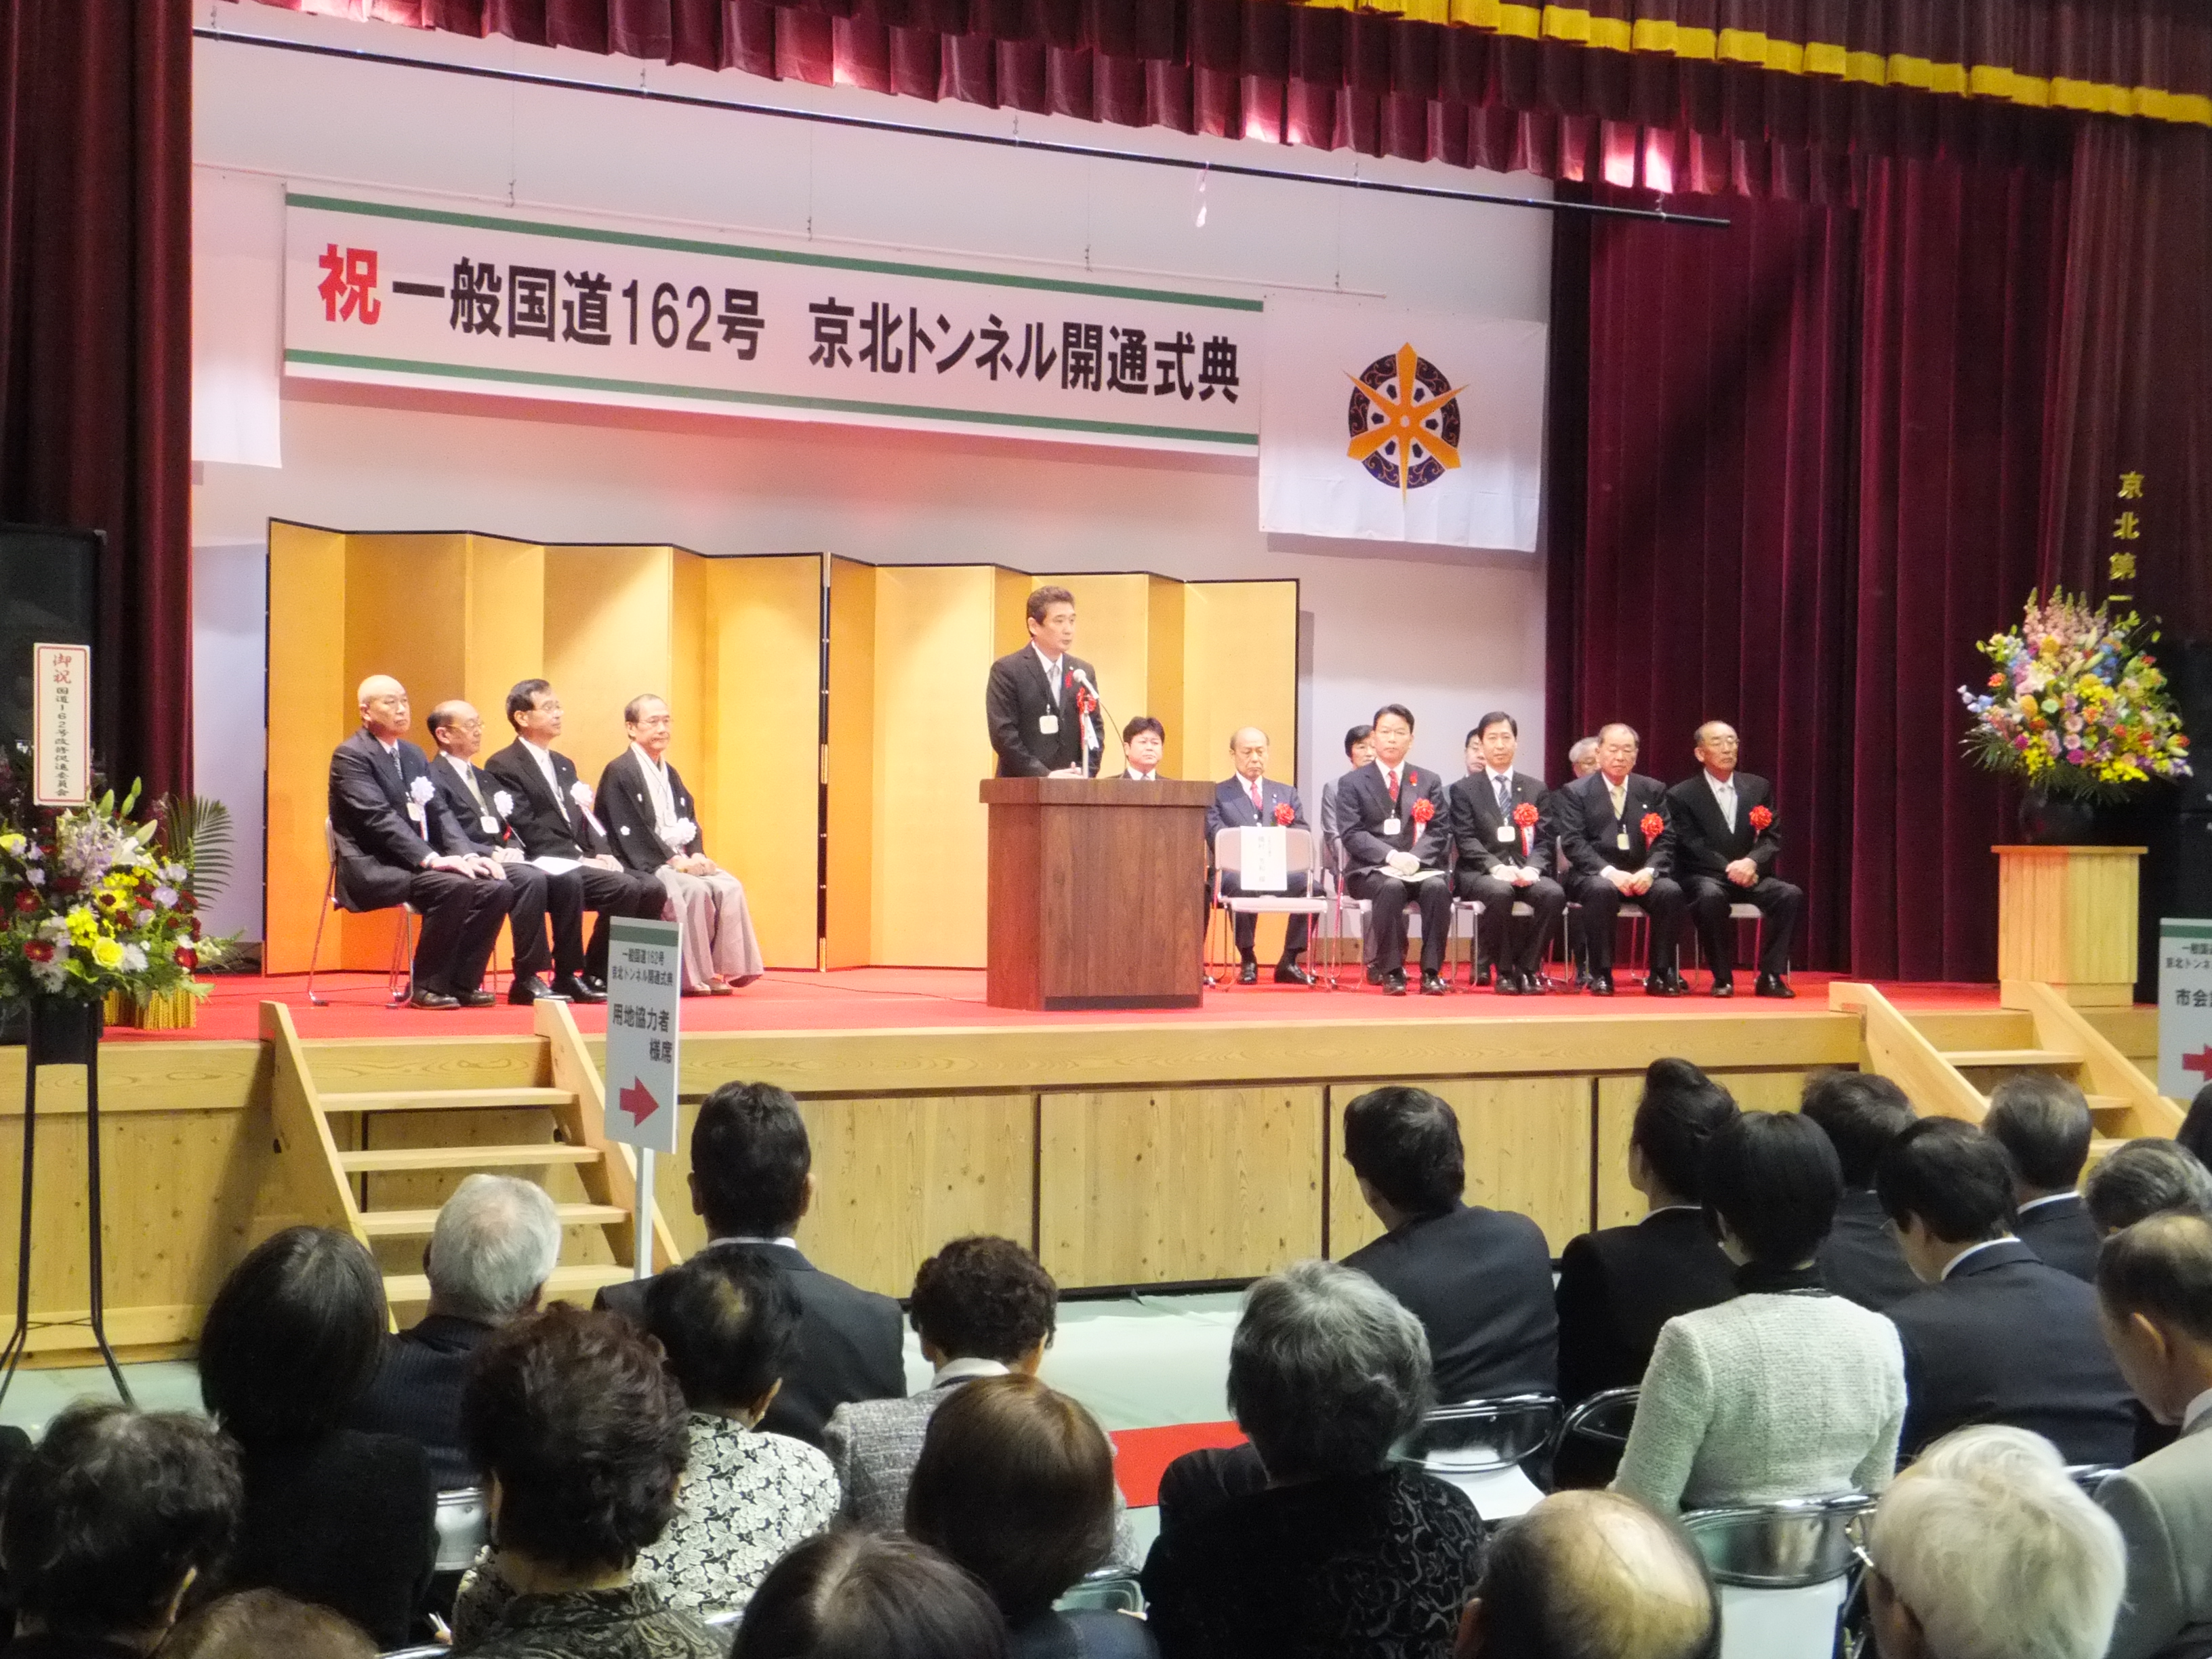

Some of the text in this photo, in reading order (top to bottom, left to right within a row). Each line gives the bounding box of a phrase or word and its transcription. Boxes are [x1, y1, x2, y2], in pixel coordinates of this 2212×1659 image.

[808, 297, 1240, 404] 京北トンネル開通式典
[612, 1002, 670, 1033] 用地協力者
[649, 1038, 673, 1064] 様席
